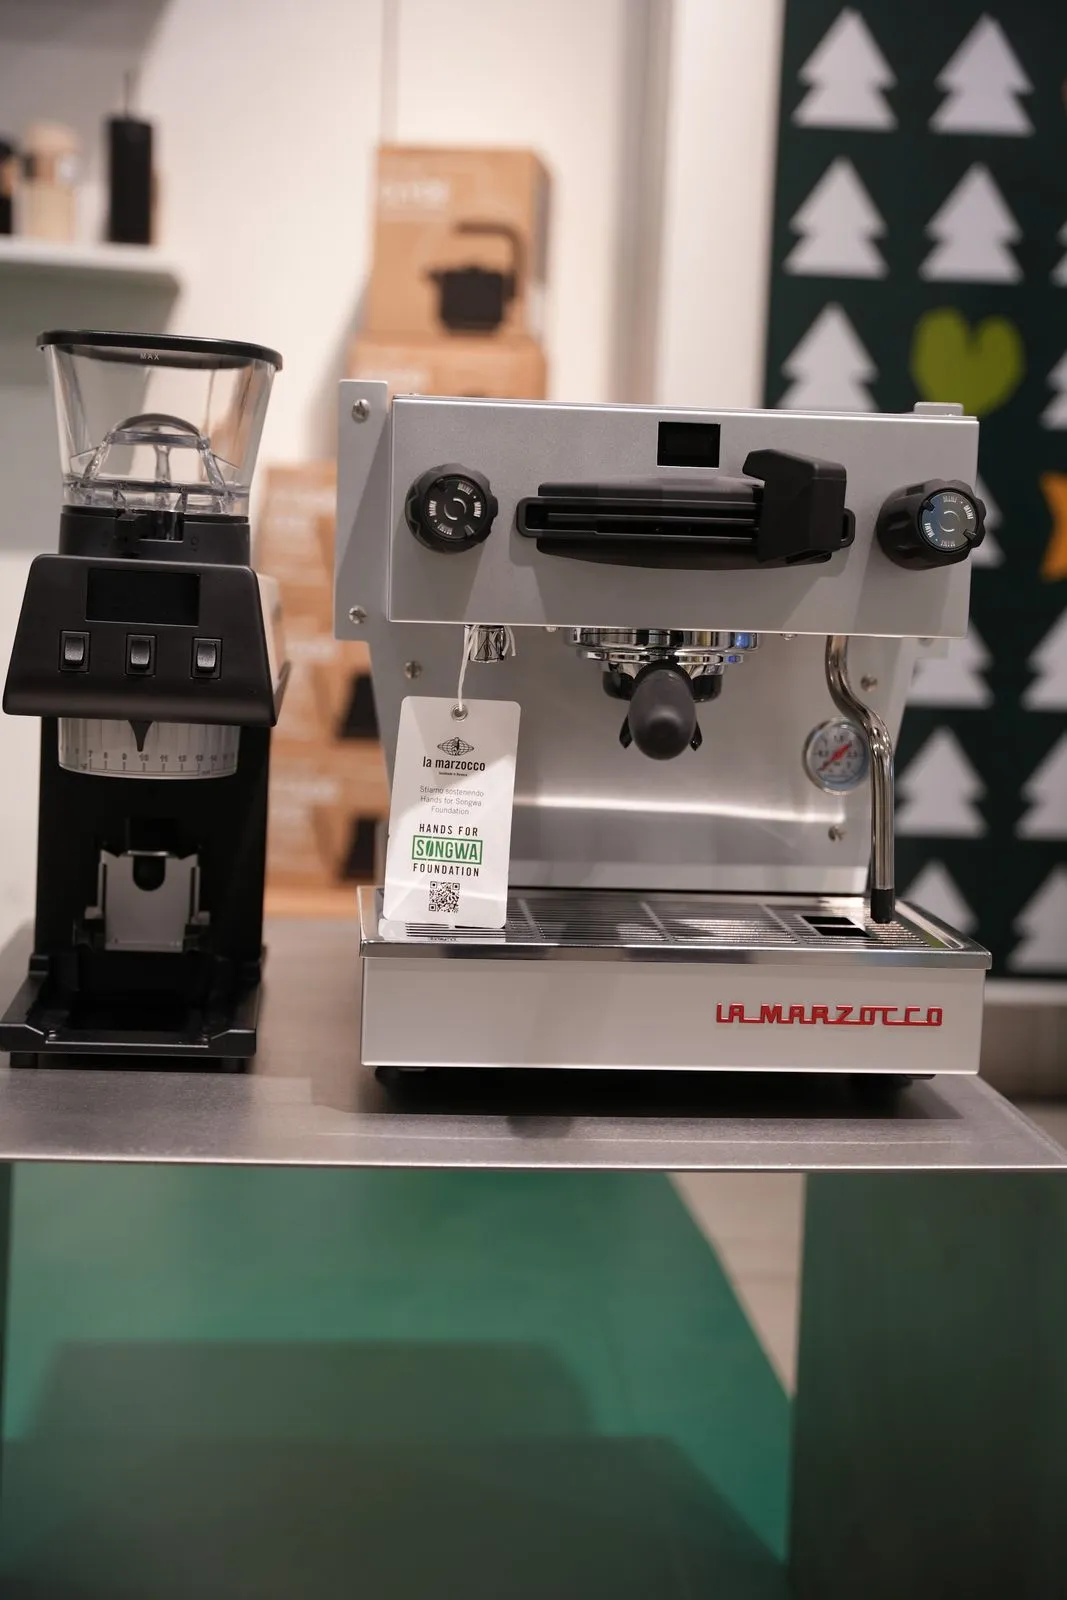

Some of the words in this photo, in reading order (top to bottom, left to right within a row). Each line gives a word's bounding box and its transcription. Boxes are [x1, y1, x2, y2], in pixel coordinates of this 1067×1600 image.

[140, 351, 160, 361] MAX
[422, 756, 432, 768] la
[435, 759, 486, 771] marzocco
[419, 785, 444, 794] Stiamo
[445, 787, 485, 797] sostenendo
[420, 795, 442, 804] Hands
[443, 796, 453, 804] for
[455, 798, 482, 807] Songwa
[431, 805, 470, 815] Foundation
[419, 823, 453, 835] HANDS
[458, 826, 478, 837] FOR
[416, 839, 478, 861] SONGWA
[413, 862, 480, 877] FOUNDATION
[716, 1003, 745, 1023] LA
[760, 1004, 943, 1026] MARZOCCO
